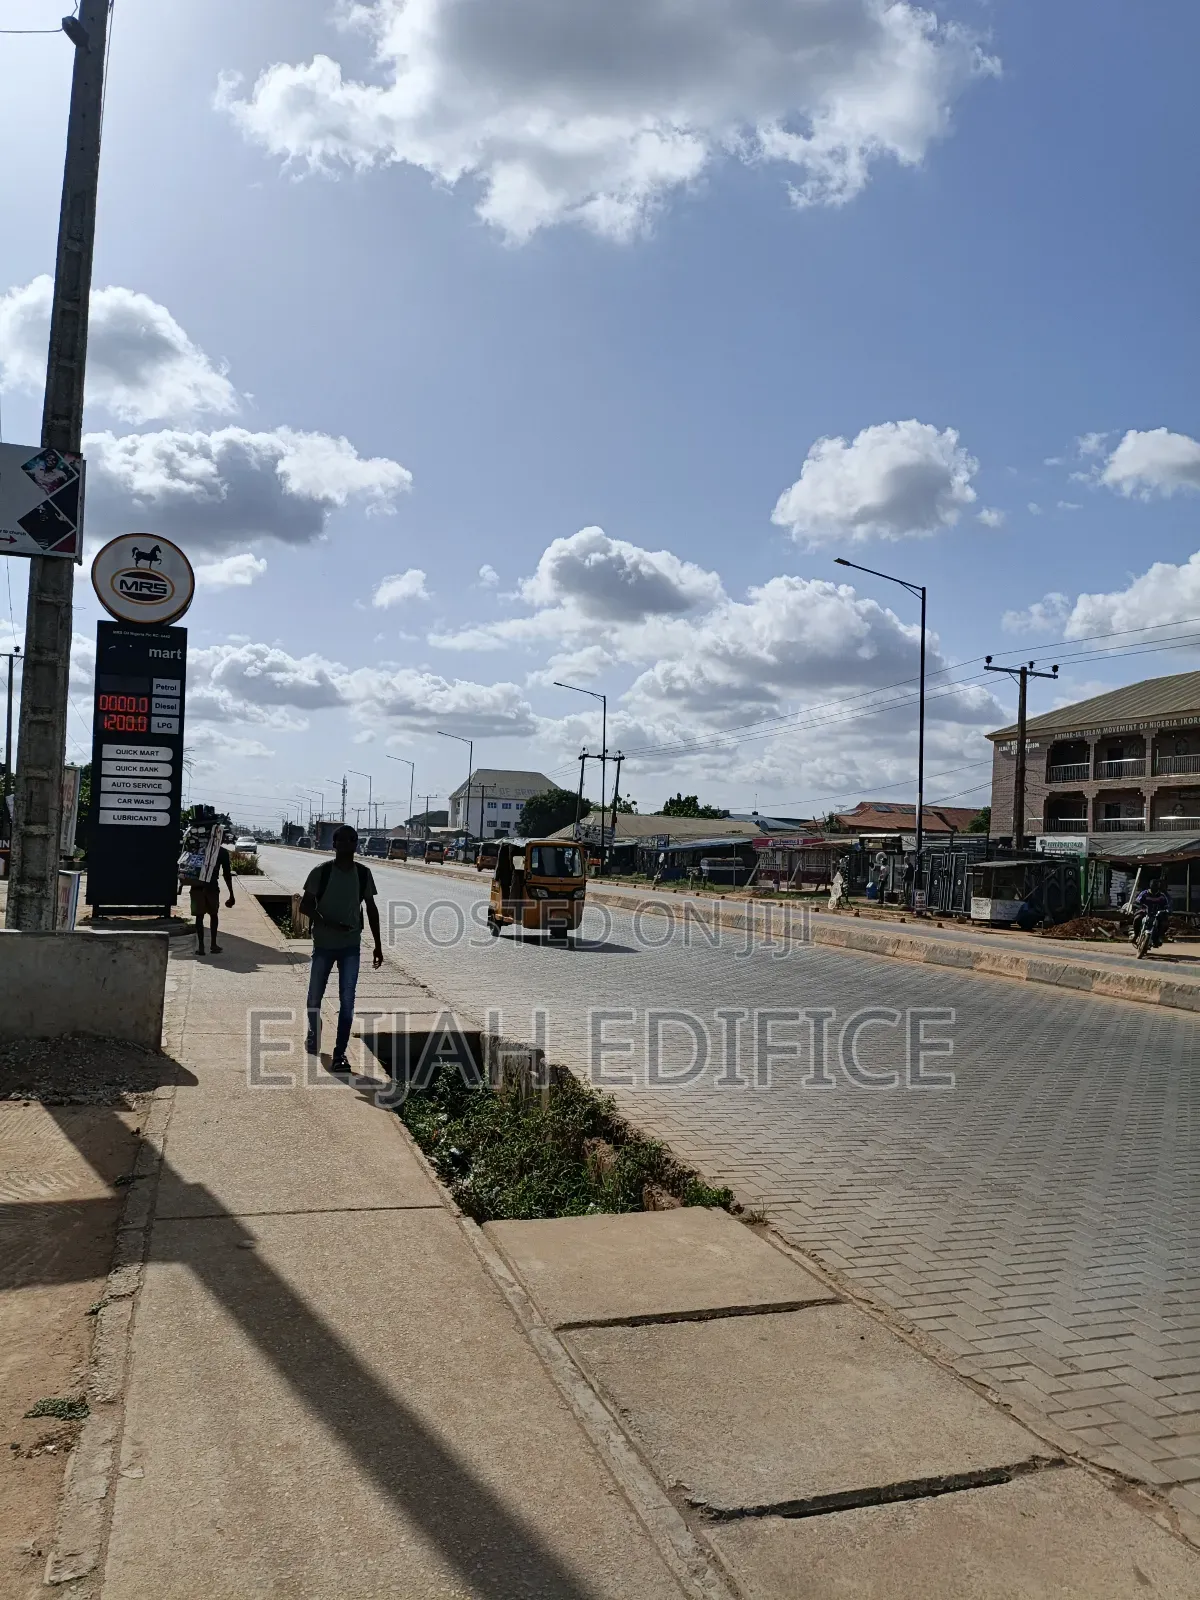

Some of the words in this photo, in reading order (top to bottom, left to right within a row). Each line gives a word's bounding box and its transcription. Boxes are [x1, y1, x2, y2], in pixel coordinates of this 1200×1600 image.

[119, 579, 167, 594] MRS
[148, 648, 182, 660] mart
[155, 683, 177, 691] Petrol
[154, 702, 177, 710] Diesel
[157, 721, 173, 729] LPG
[1102, 723, 1137, 734] MOVEMENT
[1139, 721, 1148, 730] OF
[115, 749, 139, 757] QUICK
[115, 765, 138, 773] QUICK
[111, 781, 131, 789] AUTO
[132, 782, 163, 790] SERVICE
[133, 798, 155, 806] WASH
[112, 814, 158, 822] LUBRICANTS
